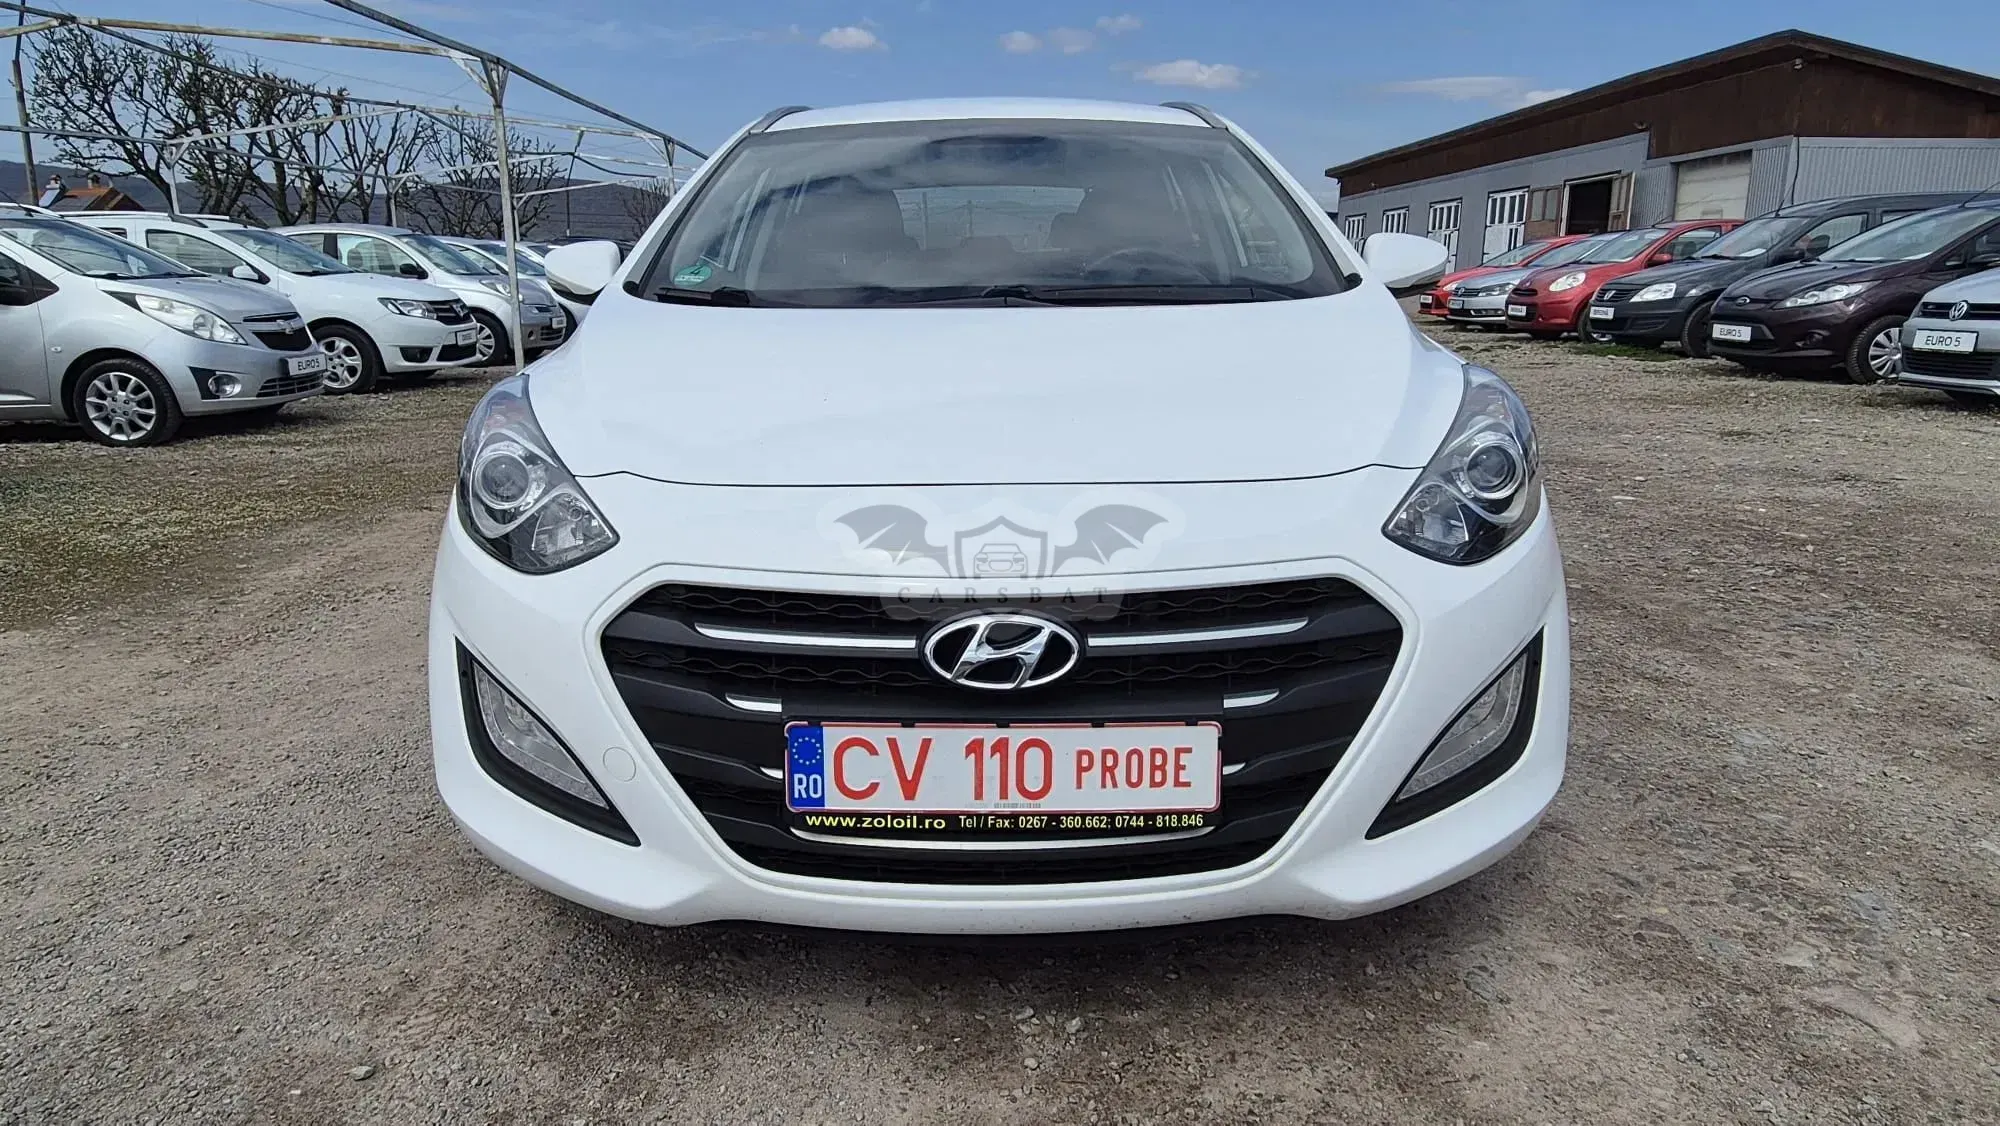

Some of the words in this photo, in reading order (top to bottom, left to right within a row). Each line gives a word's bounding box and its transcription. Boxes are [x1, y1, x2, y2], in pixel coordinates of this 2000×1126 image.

[1925, 335, 1952, 347] EURO
[1953, 336, 1962, 347] 5
[833, 736, 933, 801] CV
[965, 737, 1053, 801] 110
[1075, 747, 1193, 790] PROBE
[793, 773, 822, 799] RO
[805, 814, 946, 829] www.zoloil.ro
[959, 815, 977, 828] Tel
[979, 815, 985, 828] /
[988, 815, 1014, 828] Fax:
[1018, 815, 1048, 828] 0267
[1059, 815, 1111, 829] 360.662;
[1115, 815, 1144, 828] 0744
[1156, 814, 1204, 828] 818.846
